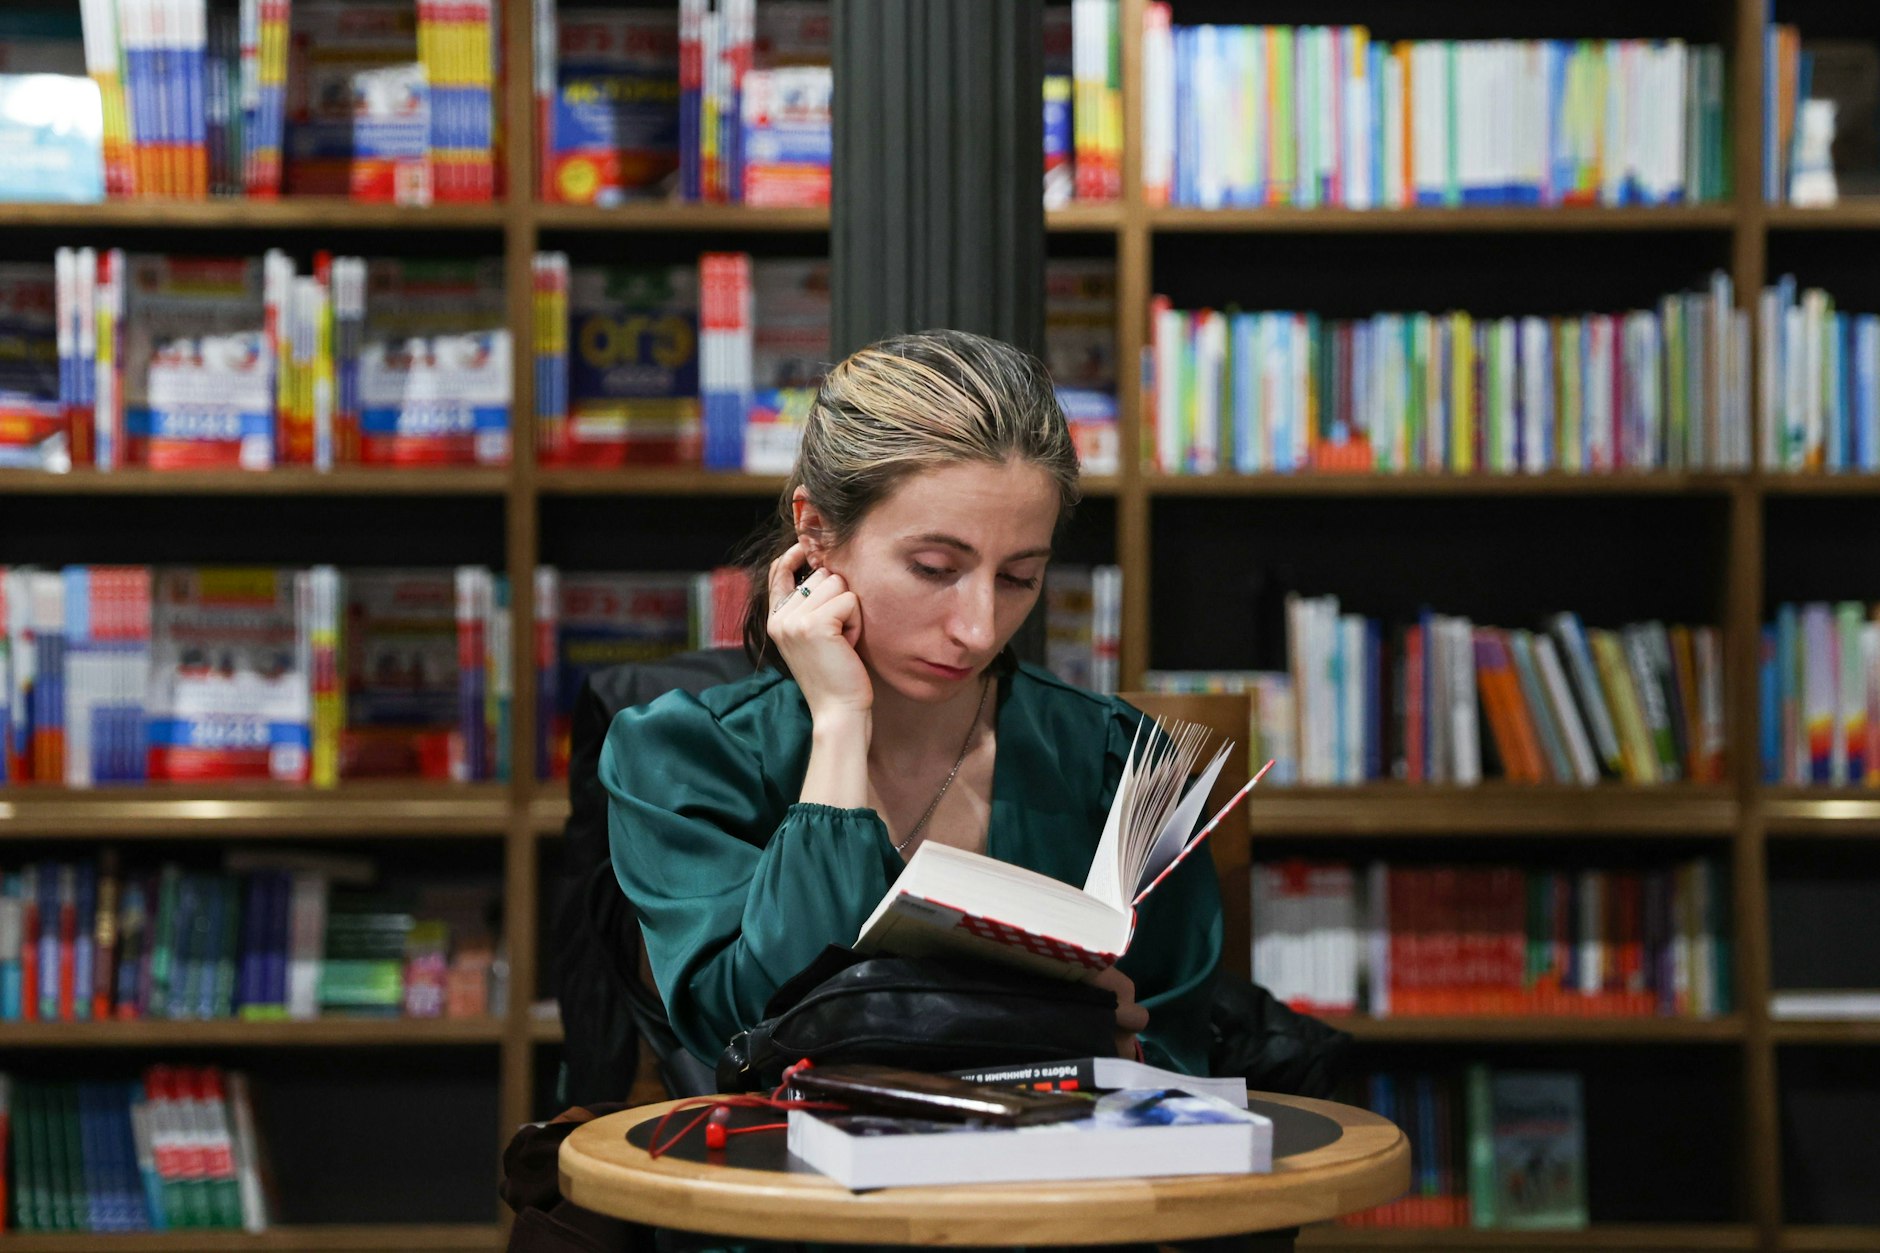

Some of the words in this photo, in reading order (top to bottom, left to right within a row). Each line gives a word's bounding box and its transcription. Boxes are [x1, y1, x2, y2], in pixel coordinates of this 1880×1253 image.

[580, 315, 692, 369] ОГЭ
[976, 1073, 983, 1083] в
[984, 1068, 1032, 1082] данными
[1033, 1069, 1040, 1078] с
[1041, 1066, 1078, 1078] Работа
